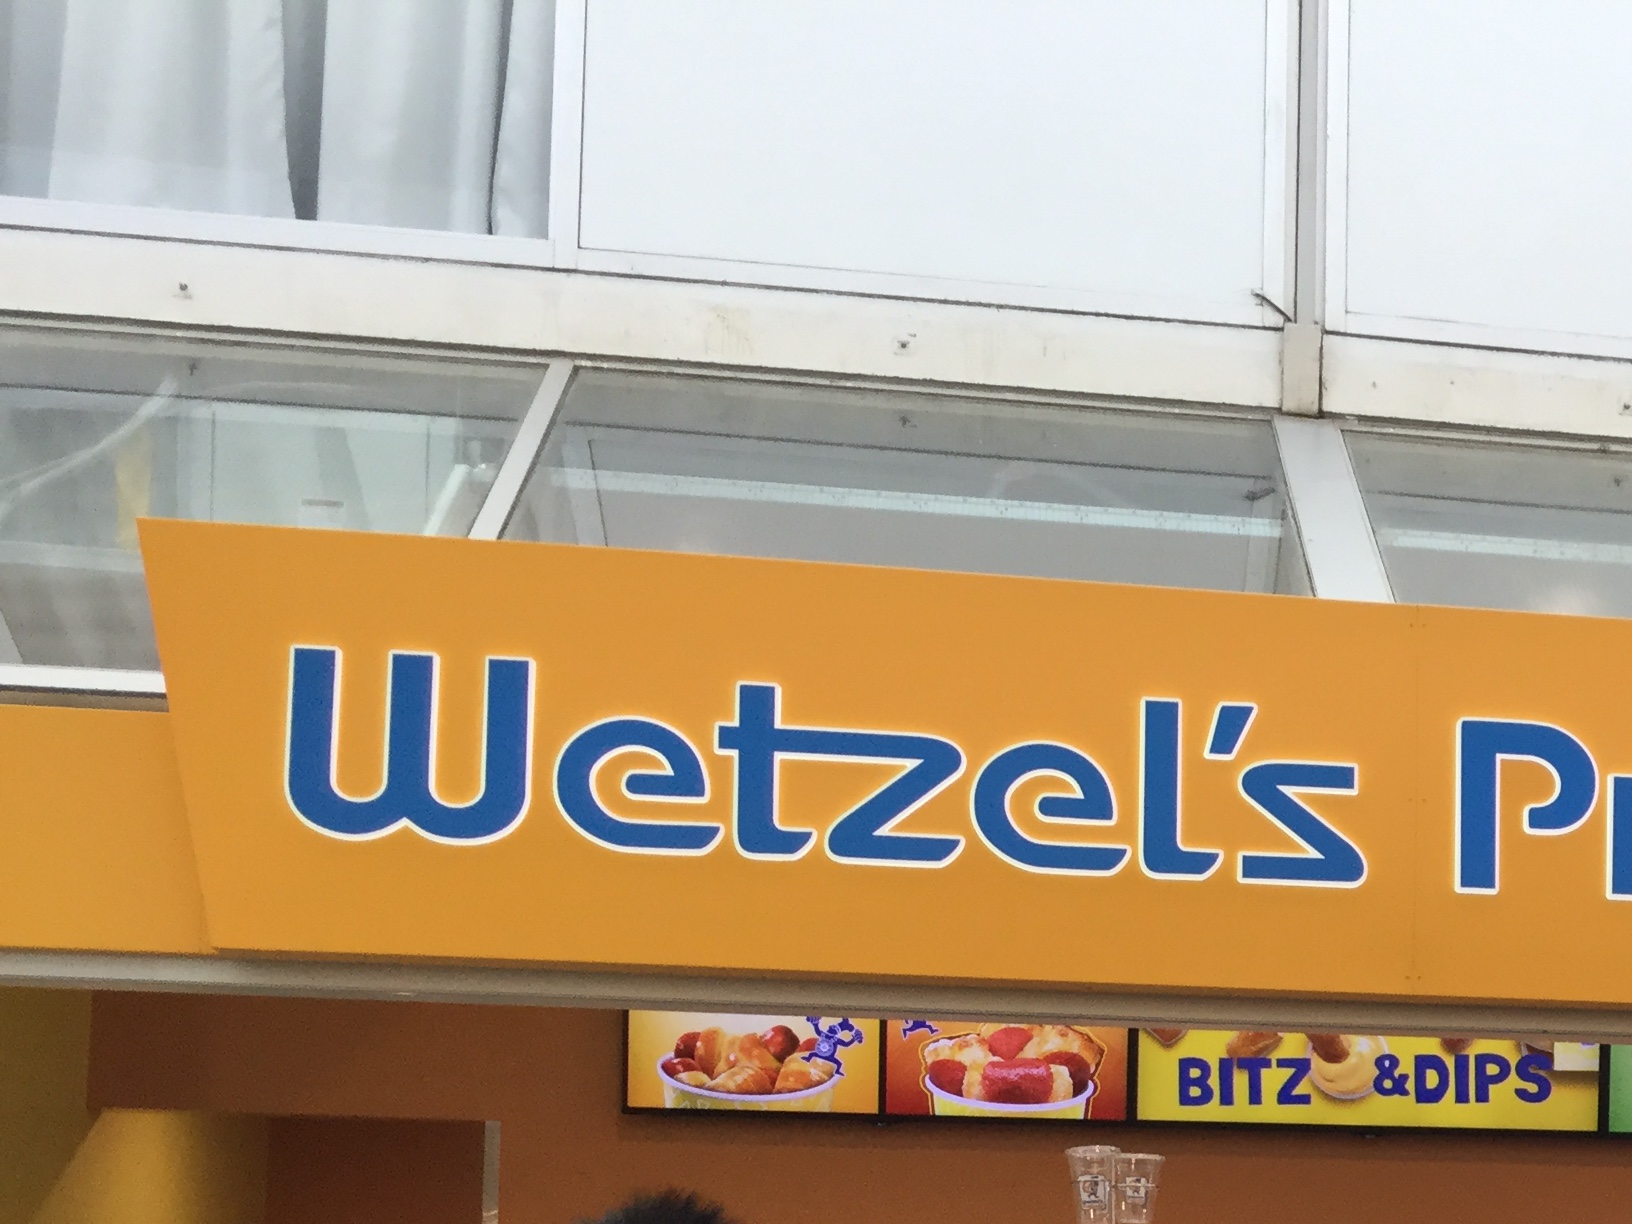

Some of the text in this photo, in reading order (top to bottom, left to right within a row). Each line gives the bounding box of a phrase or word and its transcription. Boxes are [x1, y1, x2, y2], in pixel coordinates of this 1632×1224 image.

[285, 644, 1368, 889] Wetzel's
[1178, 1053, 1553, 1107] BITZ &DIPS
